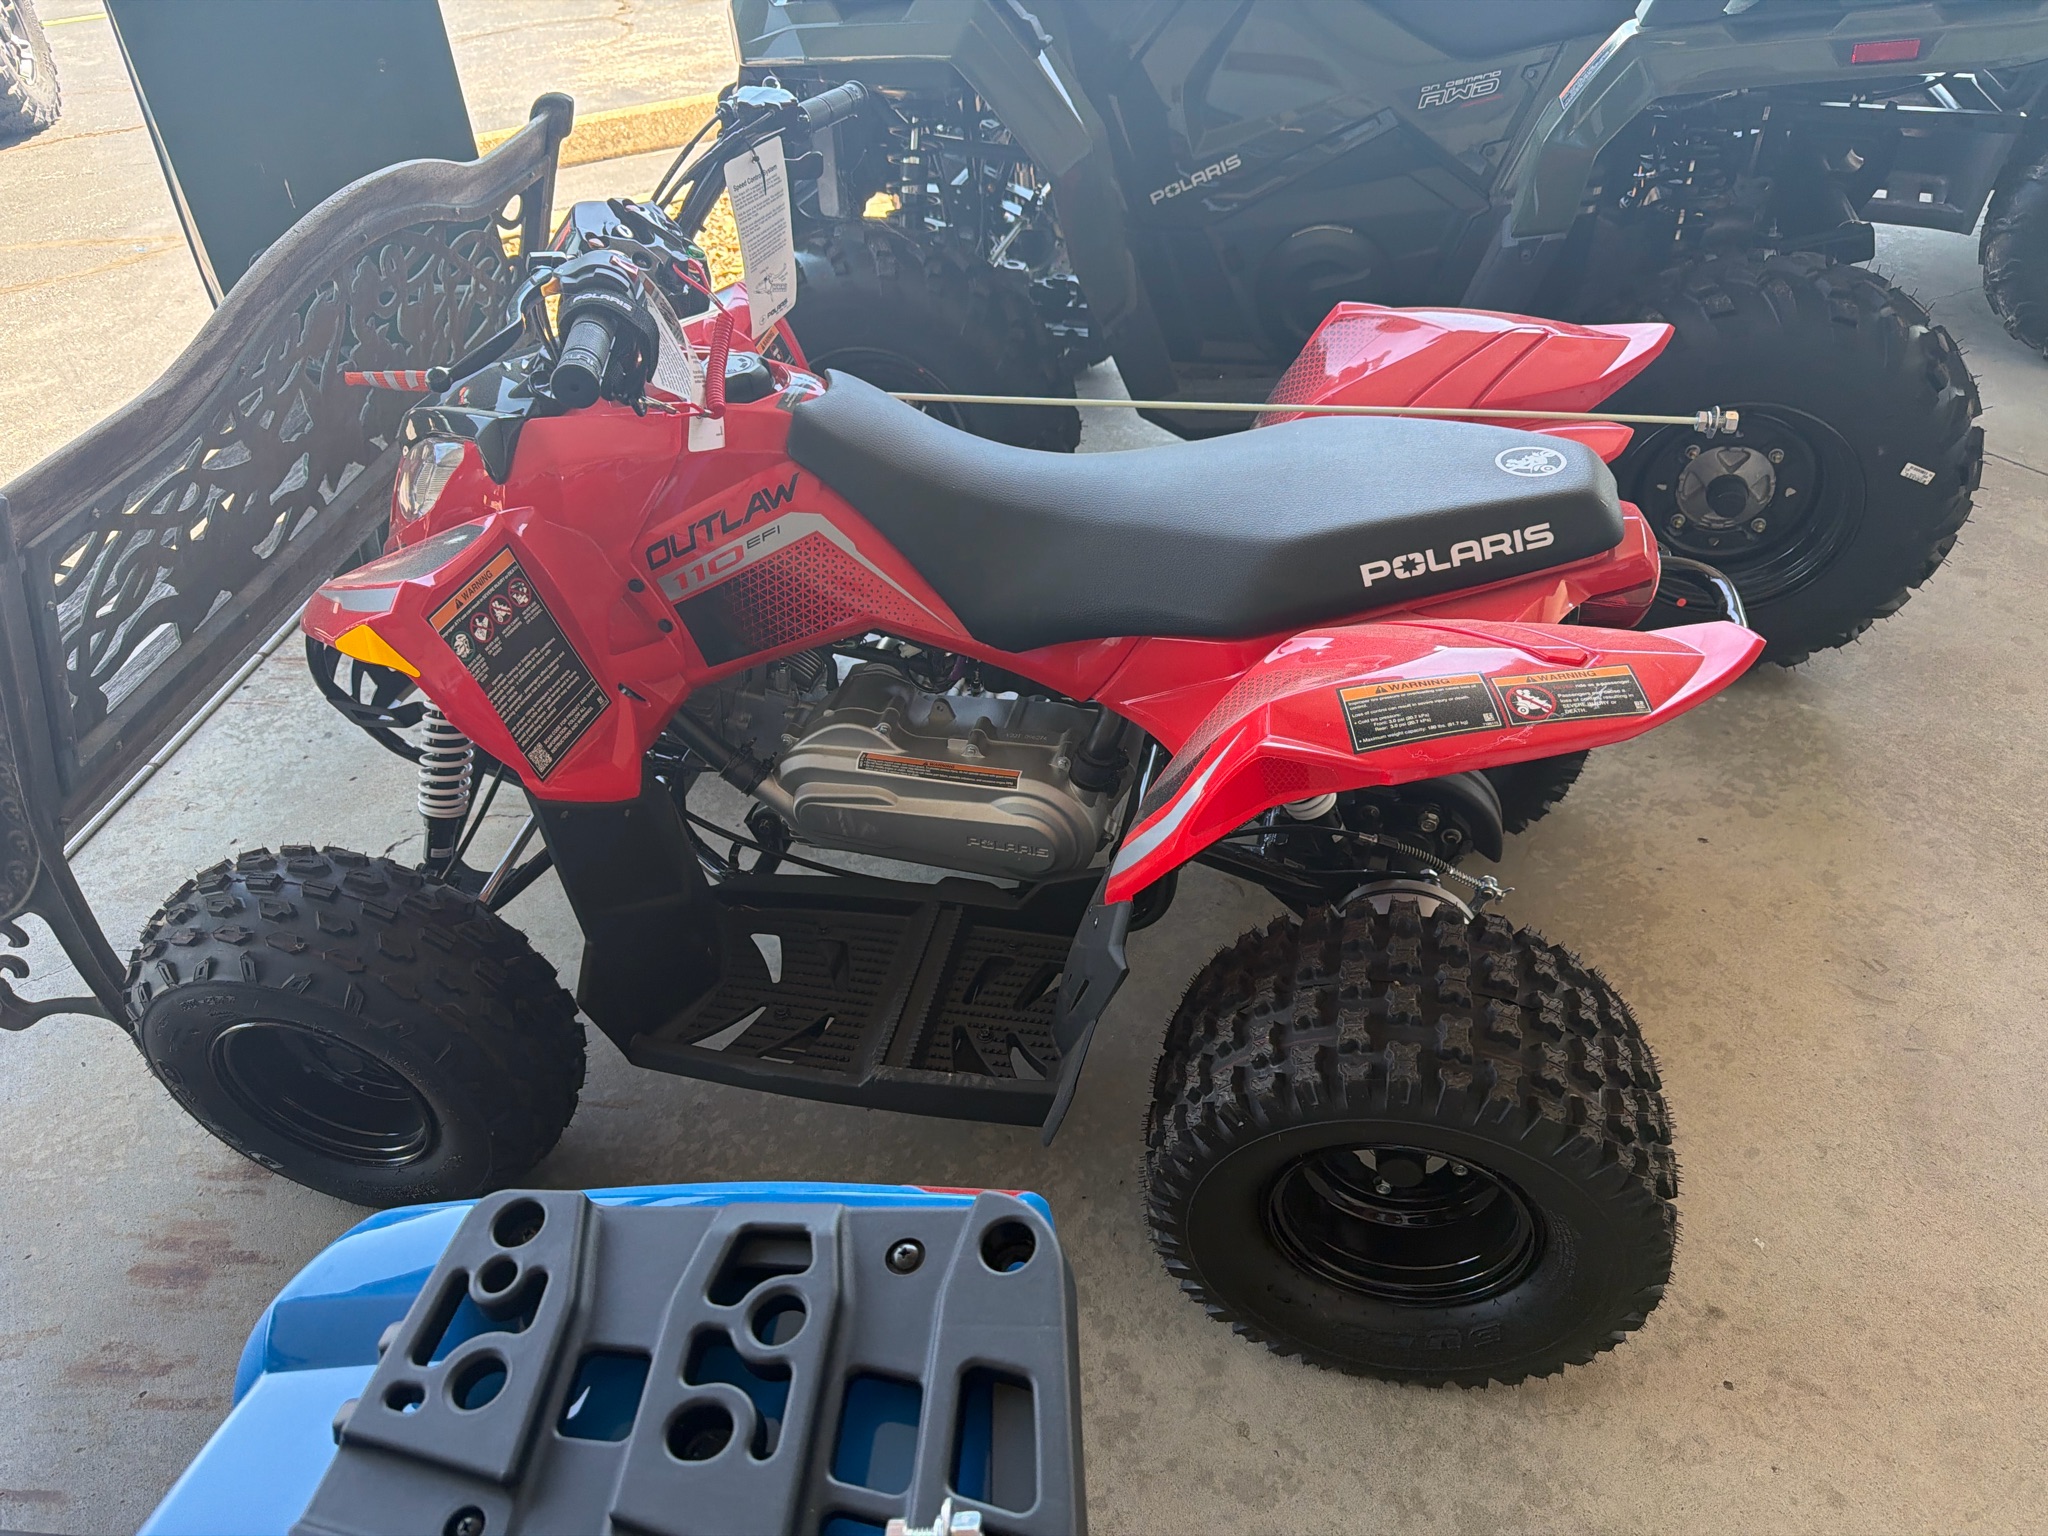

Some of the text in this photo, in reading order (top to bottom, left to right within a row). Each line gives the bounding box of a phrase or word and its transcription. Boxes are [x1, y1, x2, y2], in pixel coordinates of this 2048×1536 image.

[1421, 70, 1502, 92] ON DEMAND
[1418, 77, 1500, 110] AWD
[732, 178, 748, 192] Speed
[748, 174, 762, 186] Contro
[1150, 154, 1242, 206] POLARIS
[572, 294, 632, 312] POLARIS
[767, 298, 788, 319] POLARIS
[645, 472, 800, 570] OUTLAW
[673, 525, 780, 590] 110 EFI
[1360, 522, 1554, 588] POLARIS
[460, 569, 493, 601] WARNING
[1388, 678, 1450, 691] WARNING
[1538, 670, 1596, 682] WARNING
[967, 836, 1049, 858] POLARIS
